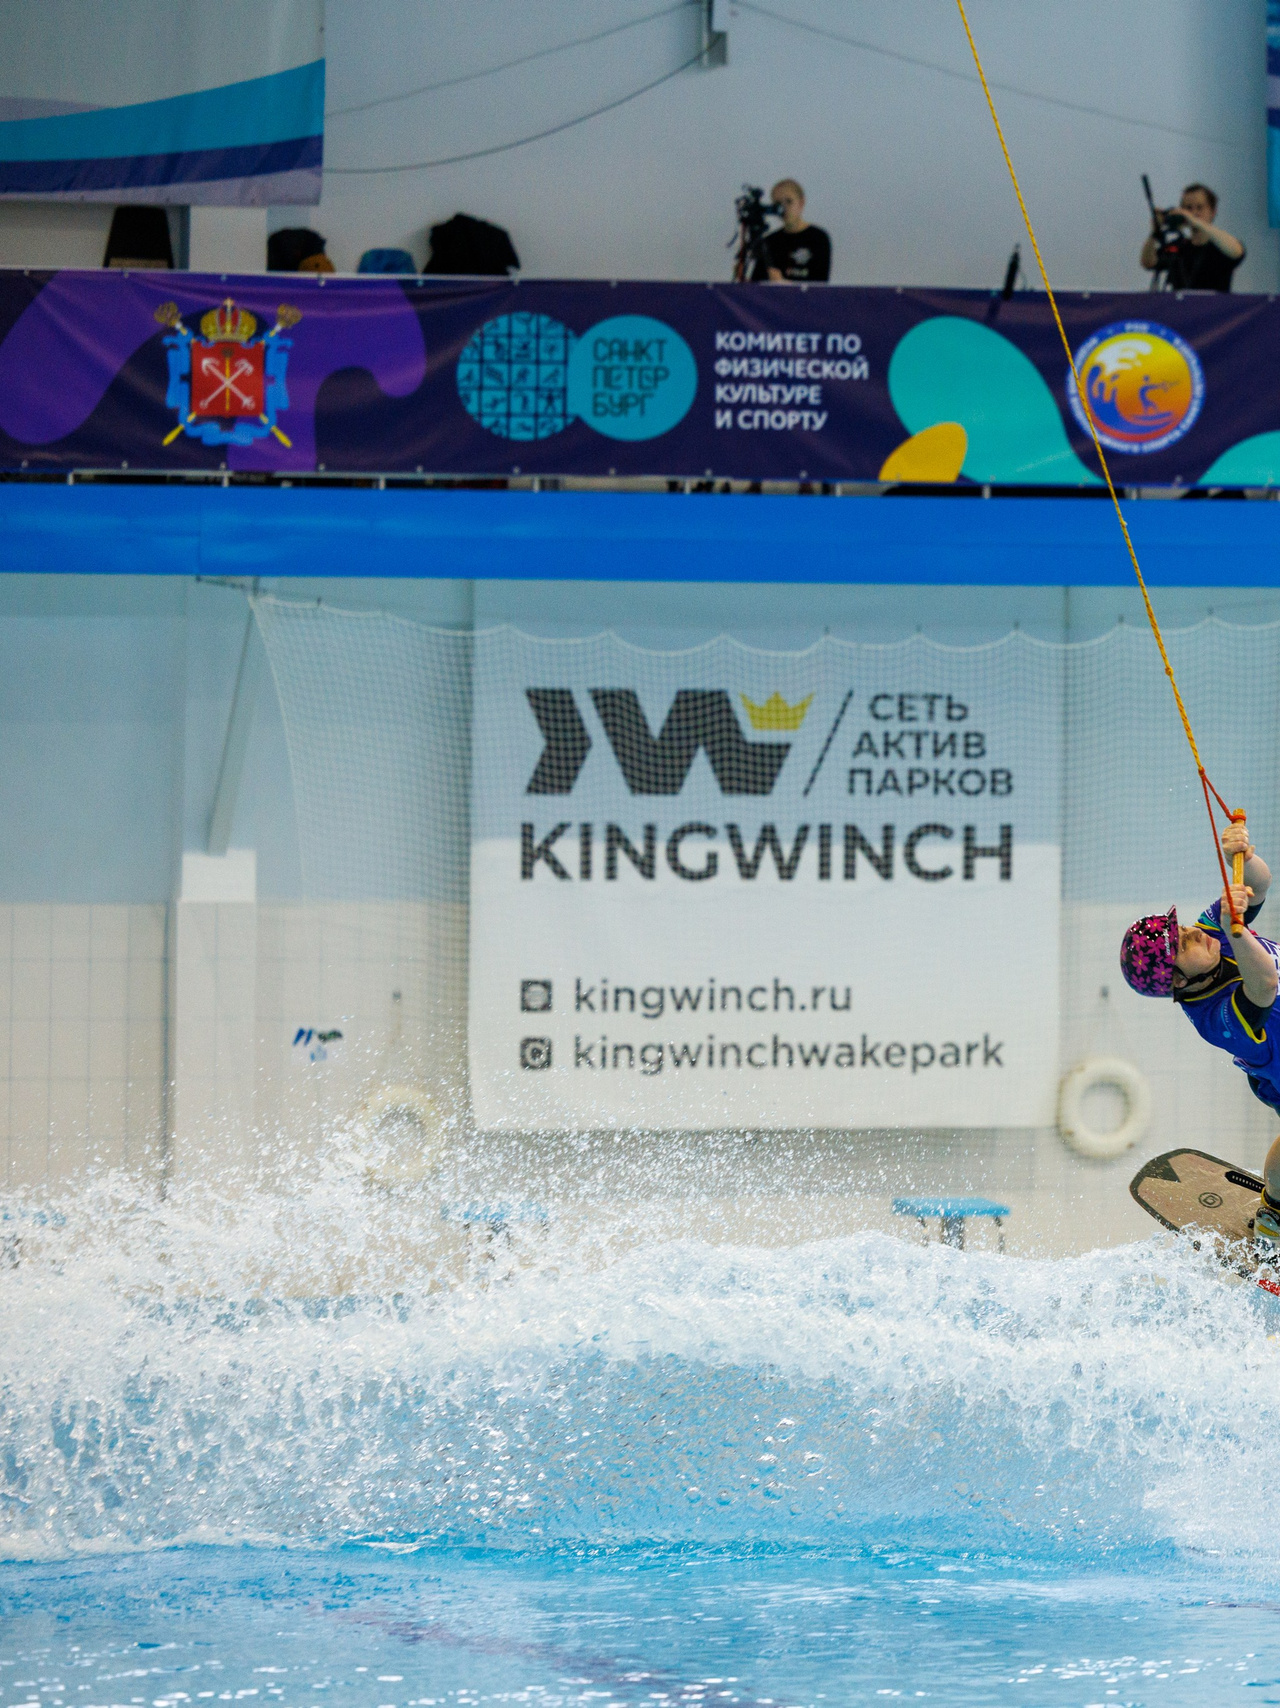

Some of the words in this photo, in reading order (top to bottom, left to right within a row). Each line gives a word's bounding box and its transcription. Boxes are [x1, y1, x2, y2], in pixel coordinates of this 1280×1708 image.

[592, 337, 666, 362] САНКТ
[715, 330, 821, 352] КОМИТЕТ
[826, 333, 862, 354] ПО
[592, 365, 670, 390] ПЕТЕР
[714, 355, 869, 380] ФИЗИЧЕСКОЙ
[592, 392, 655, 417] БУРГ
[715, 383, 822, 405] КУЛЬТУРЕ
[715, 409, 733, 429] И
[737, 410, 828, 431] СПОРТУ
[869, 693, 969, 723] СЕТЬ
[852, 731, 987, 760] АКТИВ
[847, 768, 1014, 796] ПАРКОВ
[520, 821, 1013, 881] KINGWINCH
[574, 978, 853, 1019] kingwinch.ru
[574, 1033, 1005, 1075] kingwinchwakepark
